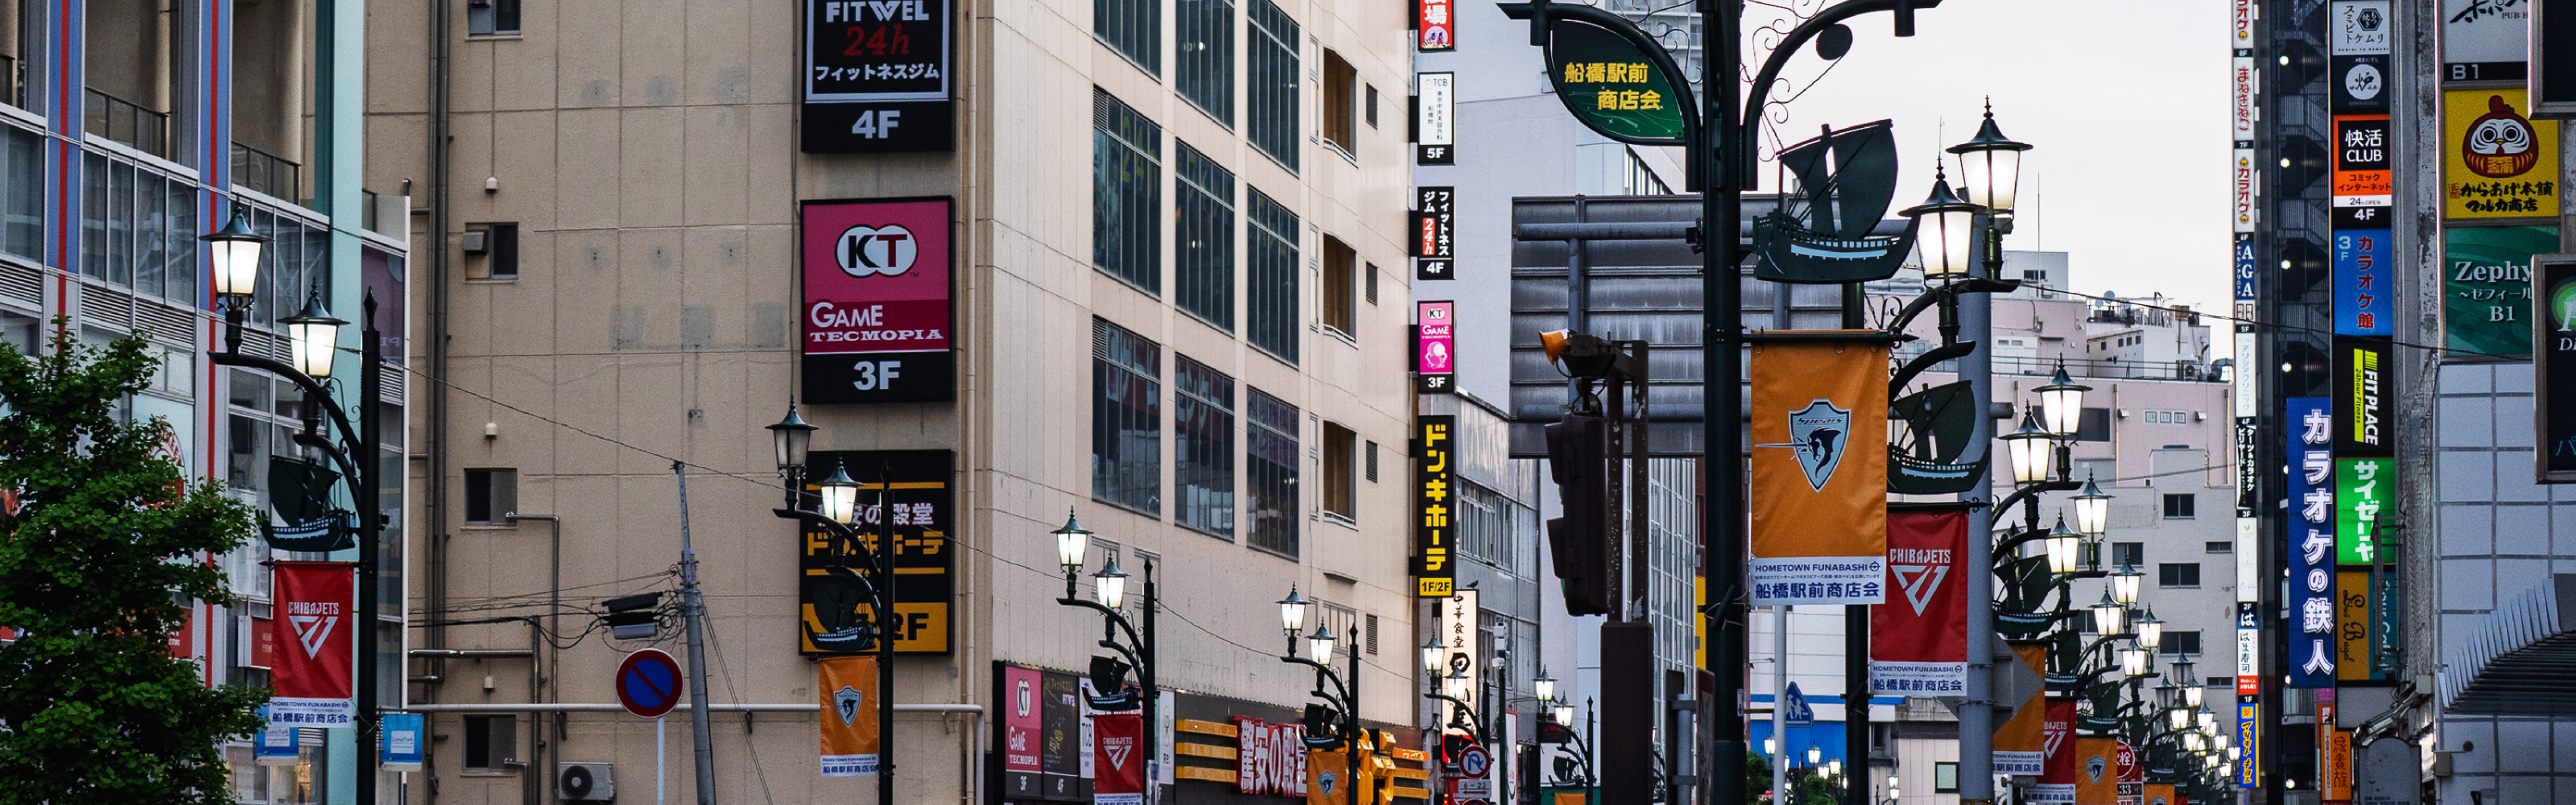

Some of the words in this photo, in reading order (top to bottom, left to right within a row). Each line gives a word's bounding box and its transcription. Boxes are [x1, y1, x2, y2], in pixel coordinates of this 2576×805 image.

[1424, 0, 1447, 25] 場
[843, 23, 910, 56] 24h
[815, 64, 940, 81] フィットネスジム
[1564, 62, 1649, 84] 船橋駅前
[2452, 64, 2479, 80] B1
[1433, 78, 1447, 87] TCB
[1598, 89, 1661, 111] 商店会
[2237, 67, 2250, 131] まねきねこ
[852, 109, 901, 139] 4F
[2345, 130, 2383, 148] 快活
[1426, 147, 1445, 159] 5F
[2346, 149, 2383, 163] CLUB
[2349, 173, 2380, 182] コミック
[2237, 167, 2250, 213] カラオケ
[2338, 182, 2392, 192] インターネット
[2459, 181, 2554, 197] からあげ本舗
[1423, 191, 1435, 213] ジム
[2465, 197, 2539, 213] マルカ商店
[2354, 208, 2375, 221] 4F
[1438, 192, 1450, 256] フィットネス
[848, 233, 908, 269] KT
[1426, 262, 1444, 274] 4F
[2241, 244, 2254, 297] AGA
[2357, 236, 2375, 329] カラオケ館
[1429, 309, 1443, 319] KT
[2489, 306, 2516, 322] B1
[810, 329, 944, 342] TECMOPIA
[853, 361, 902, 390] 3F
[1427, 377, 1445, 388] 3F
[2365, 369, 2378, 394] FIT
[2364, 395, 2378, 446] PLACE
[1425, 423, 1447, 572] ドン・キホーテ
[2301, 409, 2334, 676] カラオケの鉄人
[1889, 548, 1951, 564] CHIBAJETS
[1755, 564, 1810, 572] HOMETOWN
[1812, 564, 1868, 572] FUNABASHI
[1422, 581, 1451, 592] 1F/2F
[1755, 581, 1880, 599] 船橋駅前商店会
[287, 602, 340, 615] CHIBAJETS
[1453, 593, 1464, 648] 中華食堂
[2240, 612, 2255, 627] は
[2339, 621, 2365, 663] Bagel
[2240, 632, 2251, 674] はま寿司
[1873, 679, 1963, 691] 船橋駅前商店会
[1018, 687, 1030, 712] KT
[272, 712, 349, 724] 船橋駅前商店会
[1009, 754, 1038, 766] TECMOPIA
[1020, 776, 1027, 791] 3F
